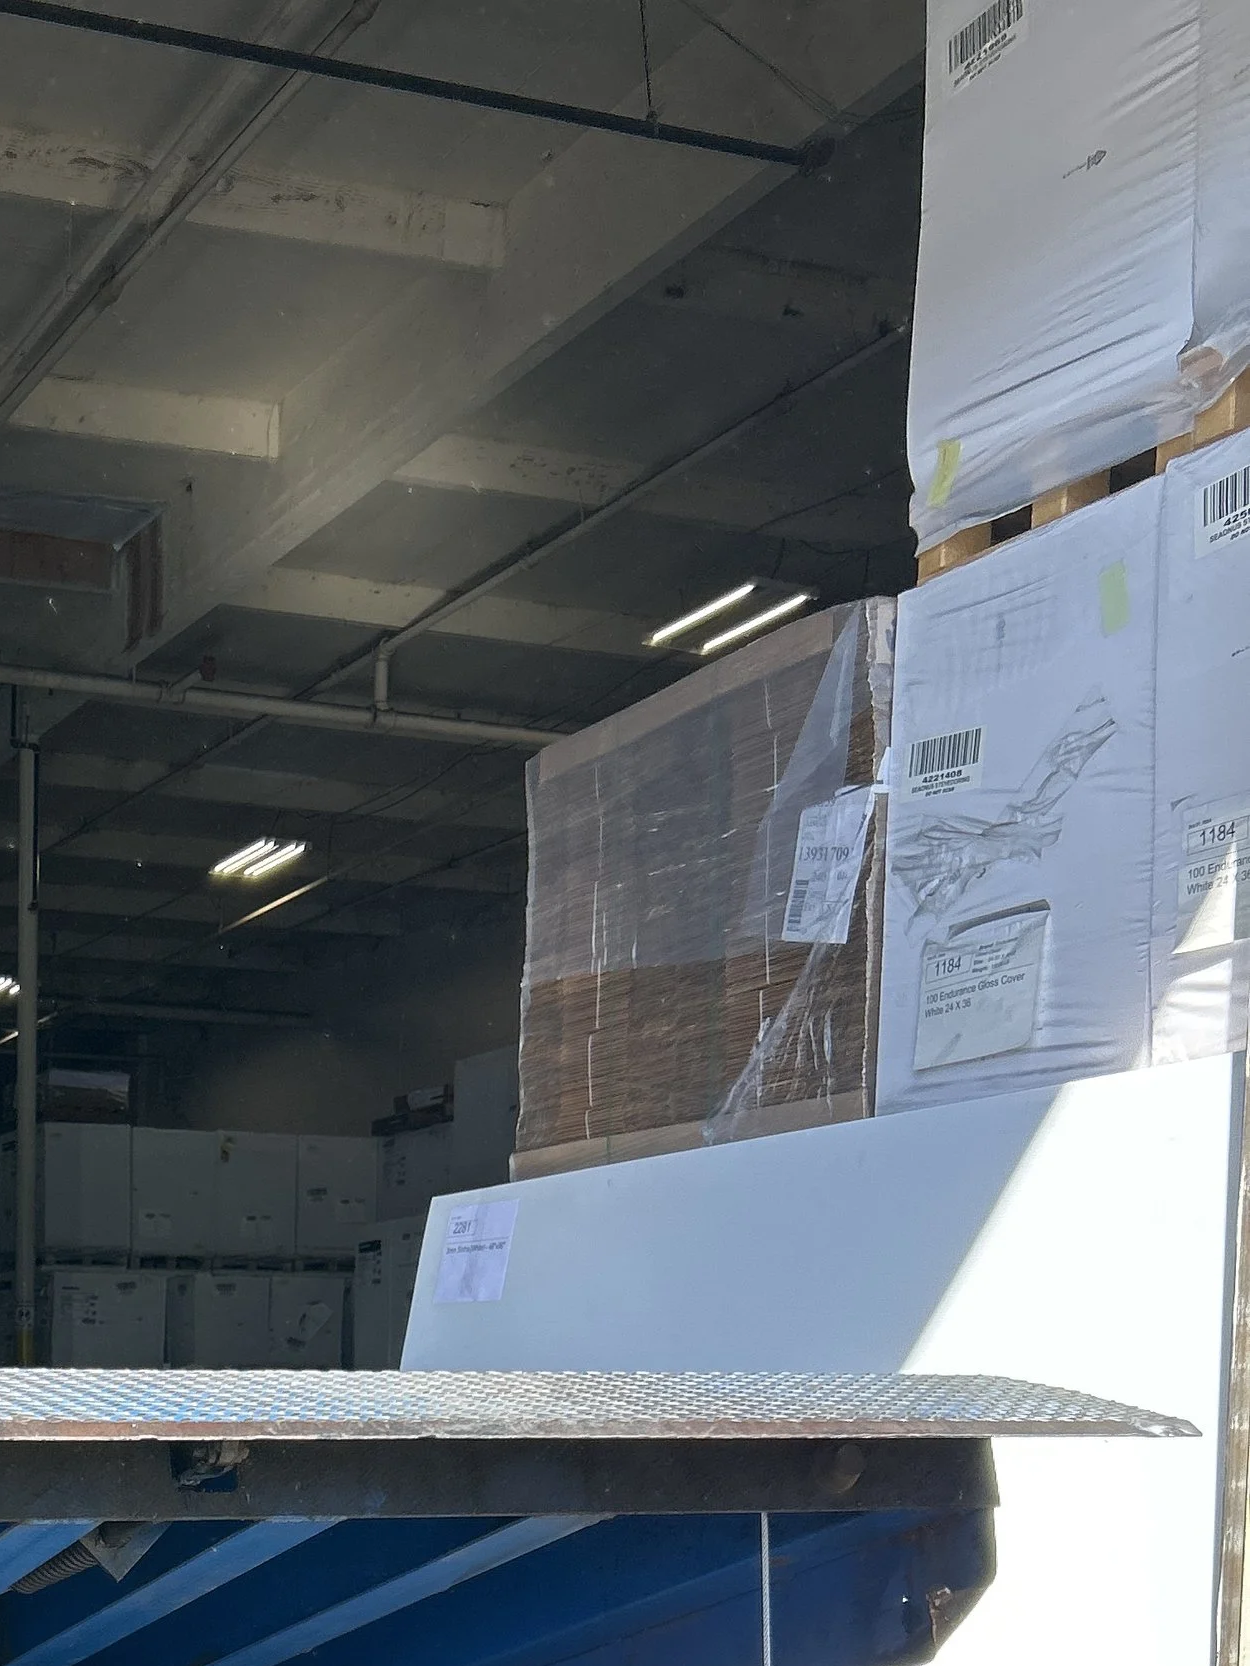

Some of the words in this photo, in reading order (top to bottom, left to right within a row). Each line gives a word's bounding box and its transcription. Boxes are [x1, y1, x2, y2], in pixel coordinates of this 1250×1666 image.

[1200, 821, 1235, 846] 1184
[1188, 866, 1205, 879] 100
[1187, 881, 1213, 895] White
[1215, 874, 1229, 888] 24
[935, 955, 961, 976] 1184
[926, 993, 938, 1004] 100
[940, 983, 976, 1001] Endurance
[978, 978, 998, 991] Gloss
[1001, 973, 1025, 985] Cover
[925, 1006, 943, 1018] White
[945, 1003, 954, 1013] 24
